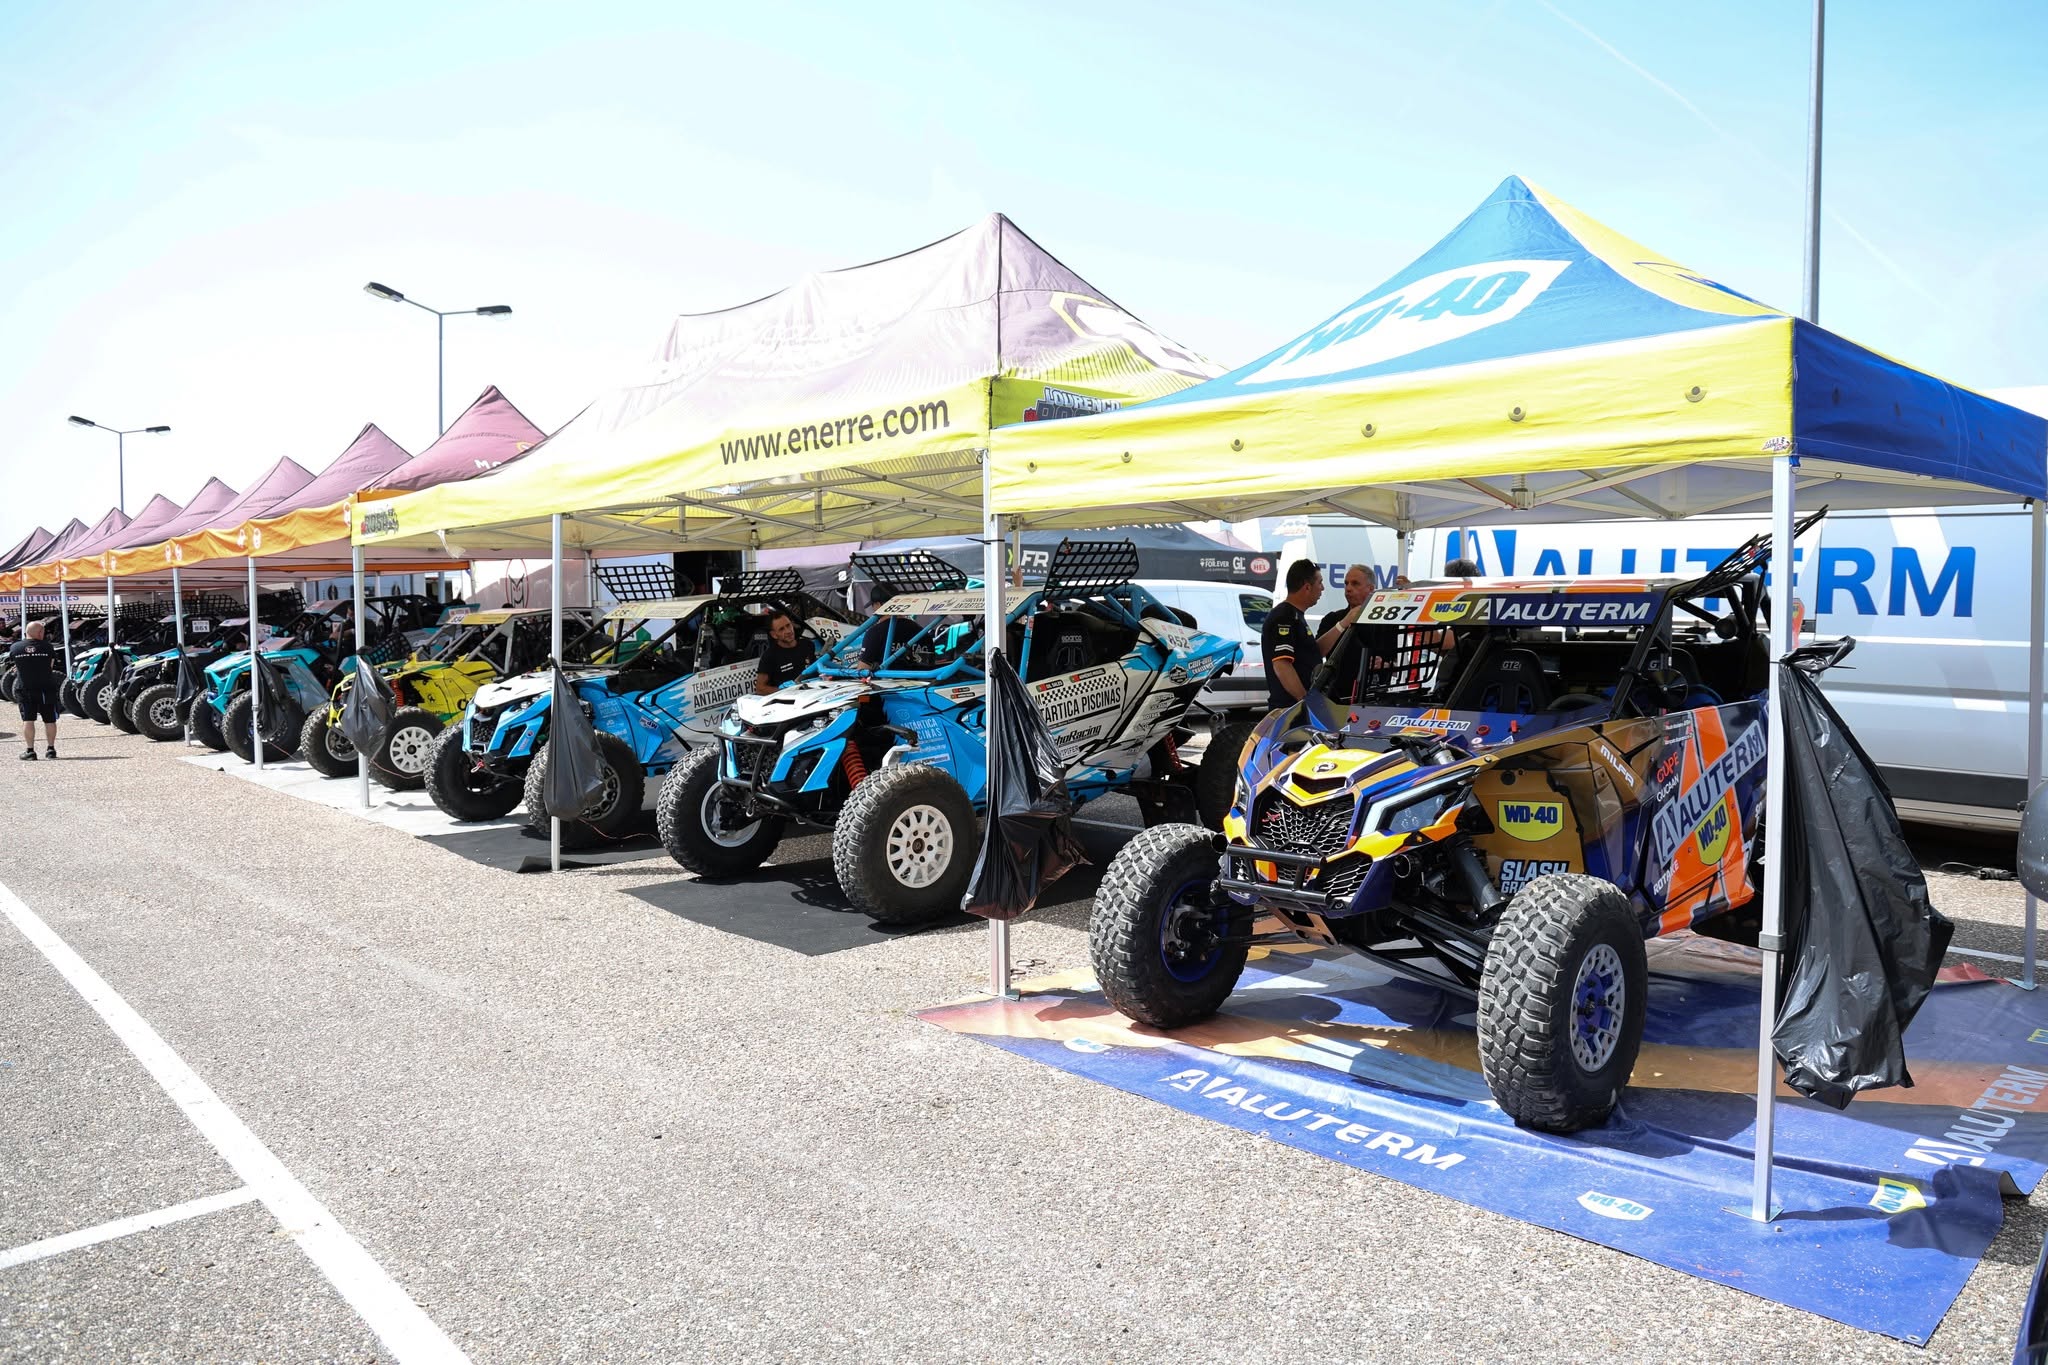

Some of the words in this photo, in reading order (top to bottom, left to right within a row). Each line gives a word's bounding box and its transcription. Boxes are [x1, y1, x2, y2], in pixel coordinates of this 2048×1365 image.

[1280, 270, 1531, 366] WD-40
[720, 399, 951, 466] www.enerre.com
[884, 604, 911, 613] 852
[1367, 606, 1419, 621] 887
[1434, 602, 1466, 613] WD-40
[1499, 602, 1651, 621] ALUTERM
[820, 627, 842, 639] 835
[1169, 634, 1191, 649] 852
[692, 680, 709, 694] TEAM
[1040, 702, 1080, 723] TÁRTICA
[1081, 687, 1121, 713] PISCINAS
[1403, 718, 1470, 731] ALUTERM
[1600, 745, 1635, 788] MILFA
[1678, 728, 1766, 838] ALUTERM
[1504, 805, 1558, 824] WD-40
[1697, 804, 1727, 851] WD-40
[1501, 881, 1527, 894] GRA
[1653, 859, 1680, 896] ROTAKE
[1944, 1064, 2048, 1153] ALUTERM
[1203, 1085, 1467, 1172] ALUTERM
[1587, 1193, 1645, 1216] WD-40
